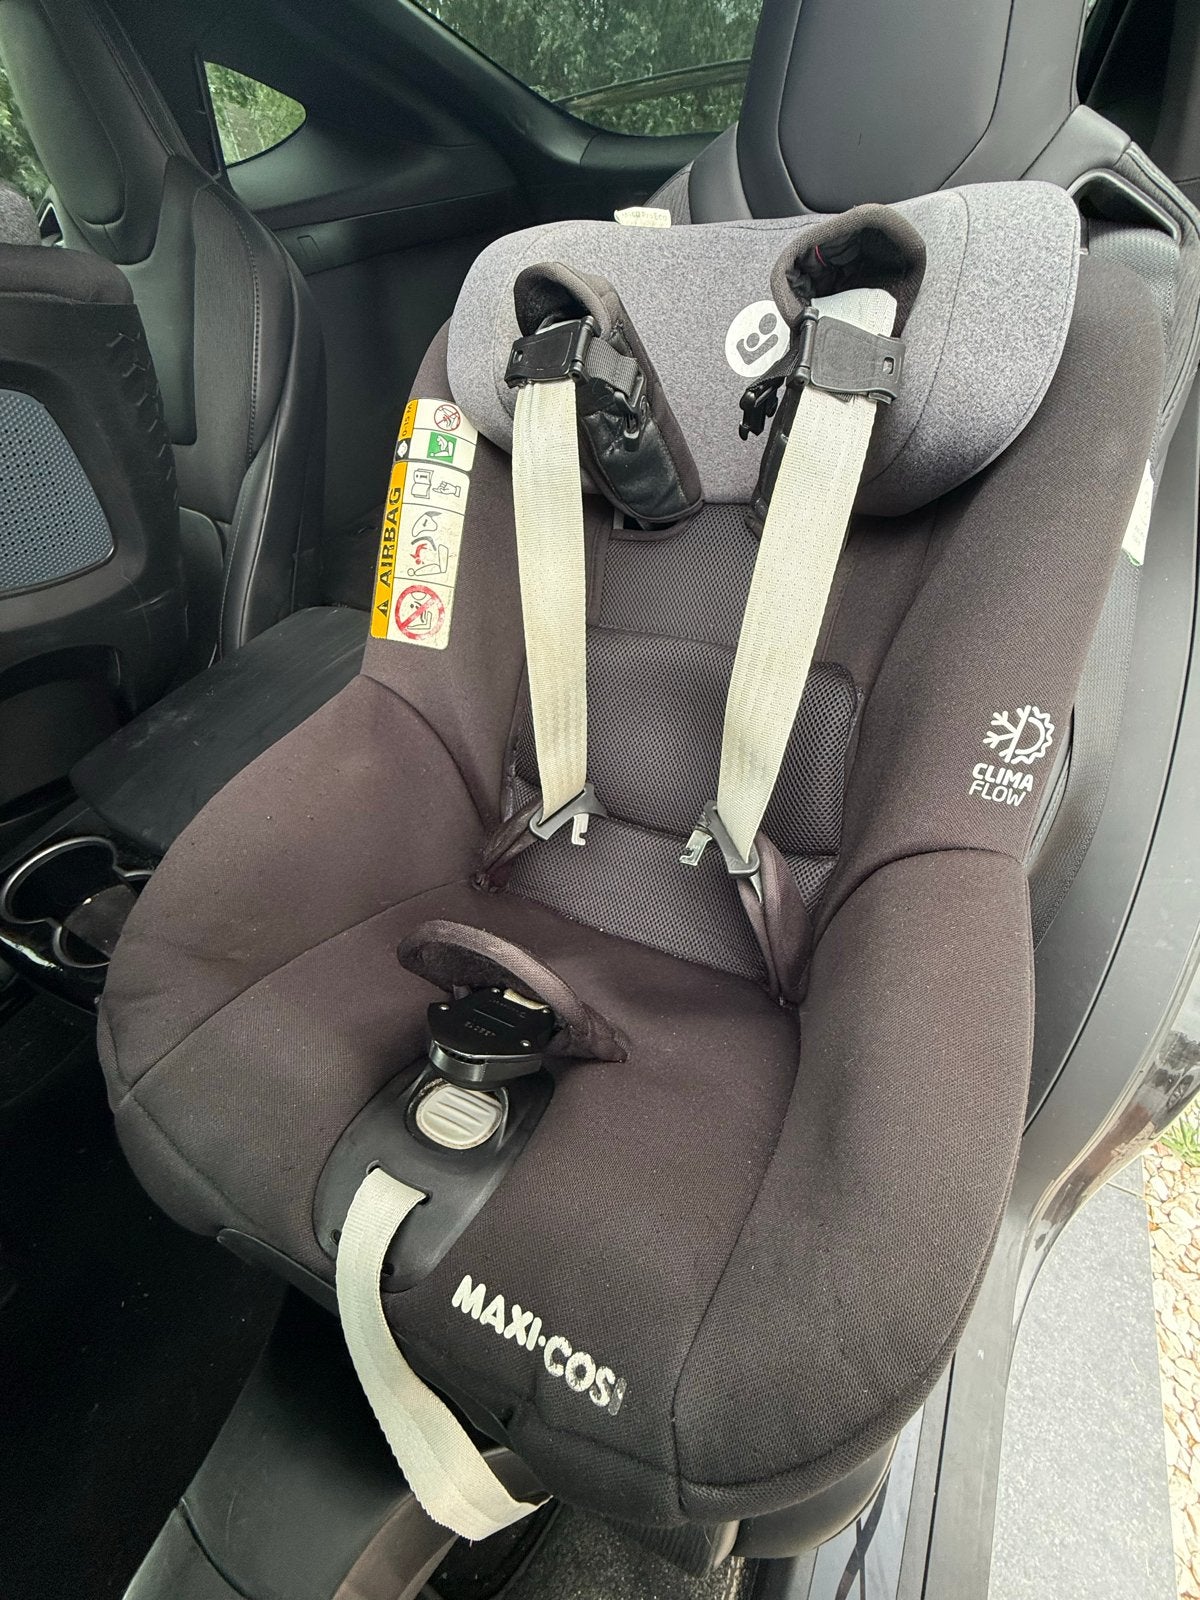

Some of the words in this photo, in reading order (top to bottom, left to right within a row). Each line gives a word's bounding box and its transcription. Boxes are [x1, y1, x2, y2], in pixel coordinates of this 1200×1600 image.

[380, 486, 402, 588] AIRBAG
[972, 762, 1034, 792] CLIMA
[968, 780, 1026, 807] FLOW
